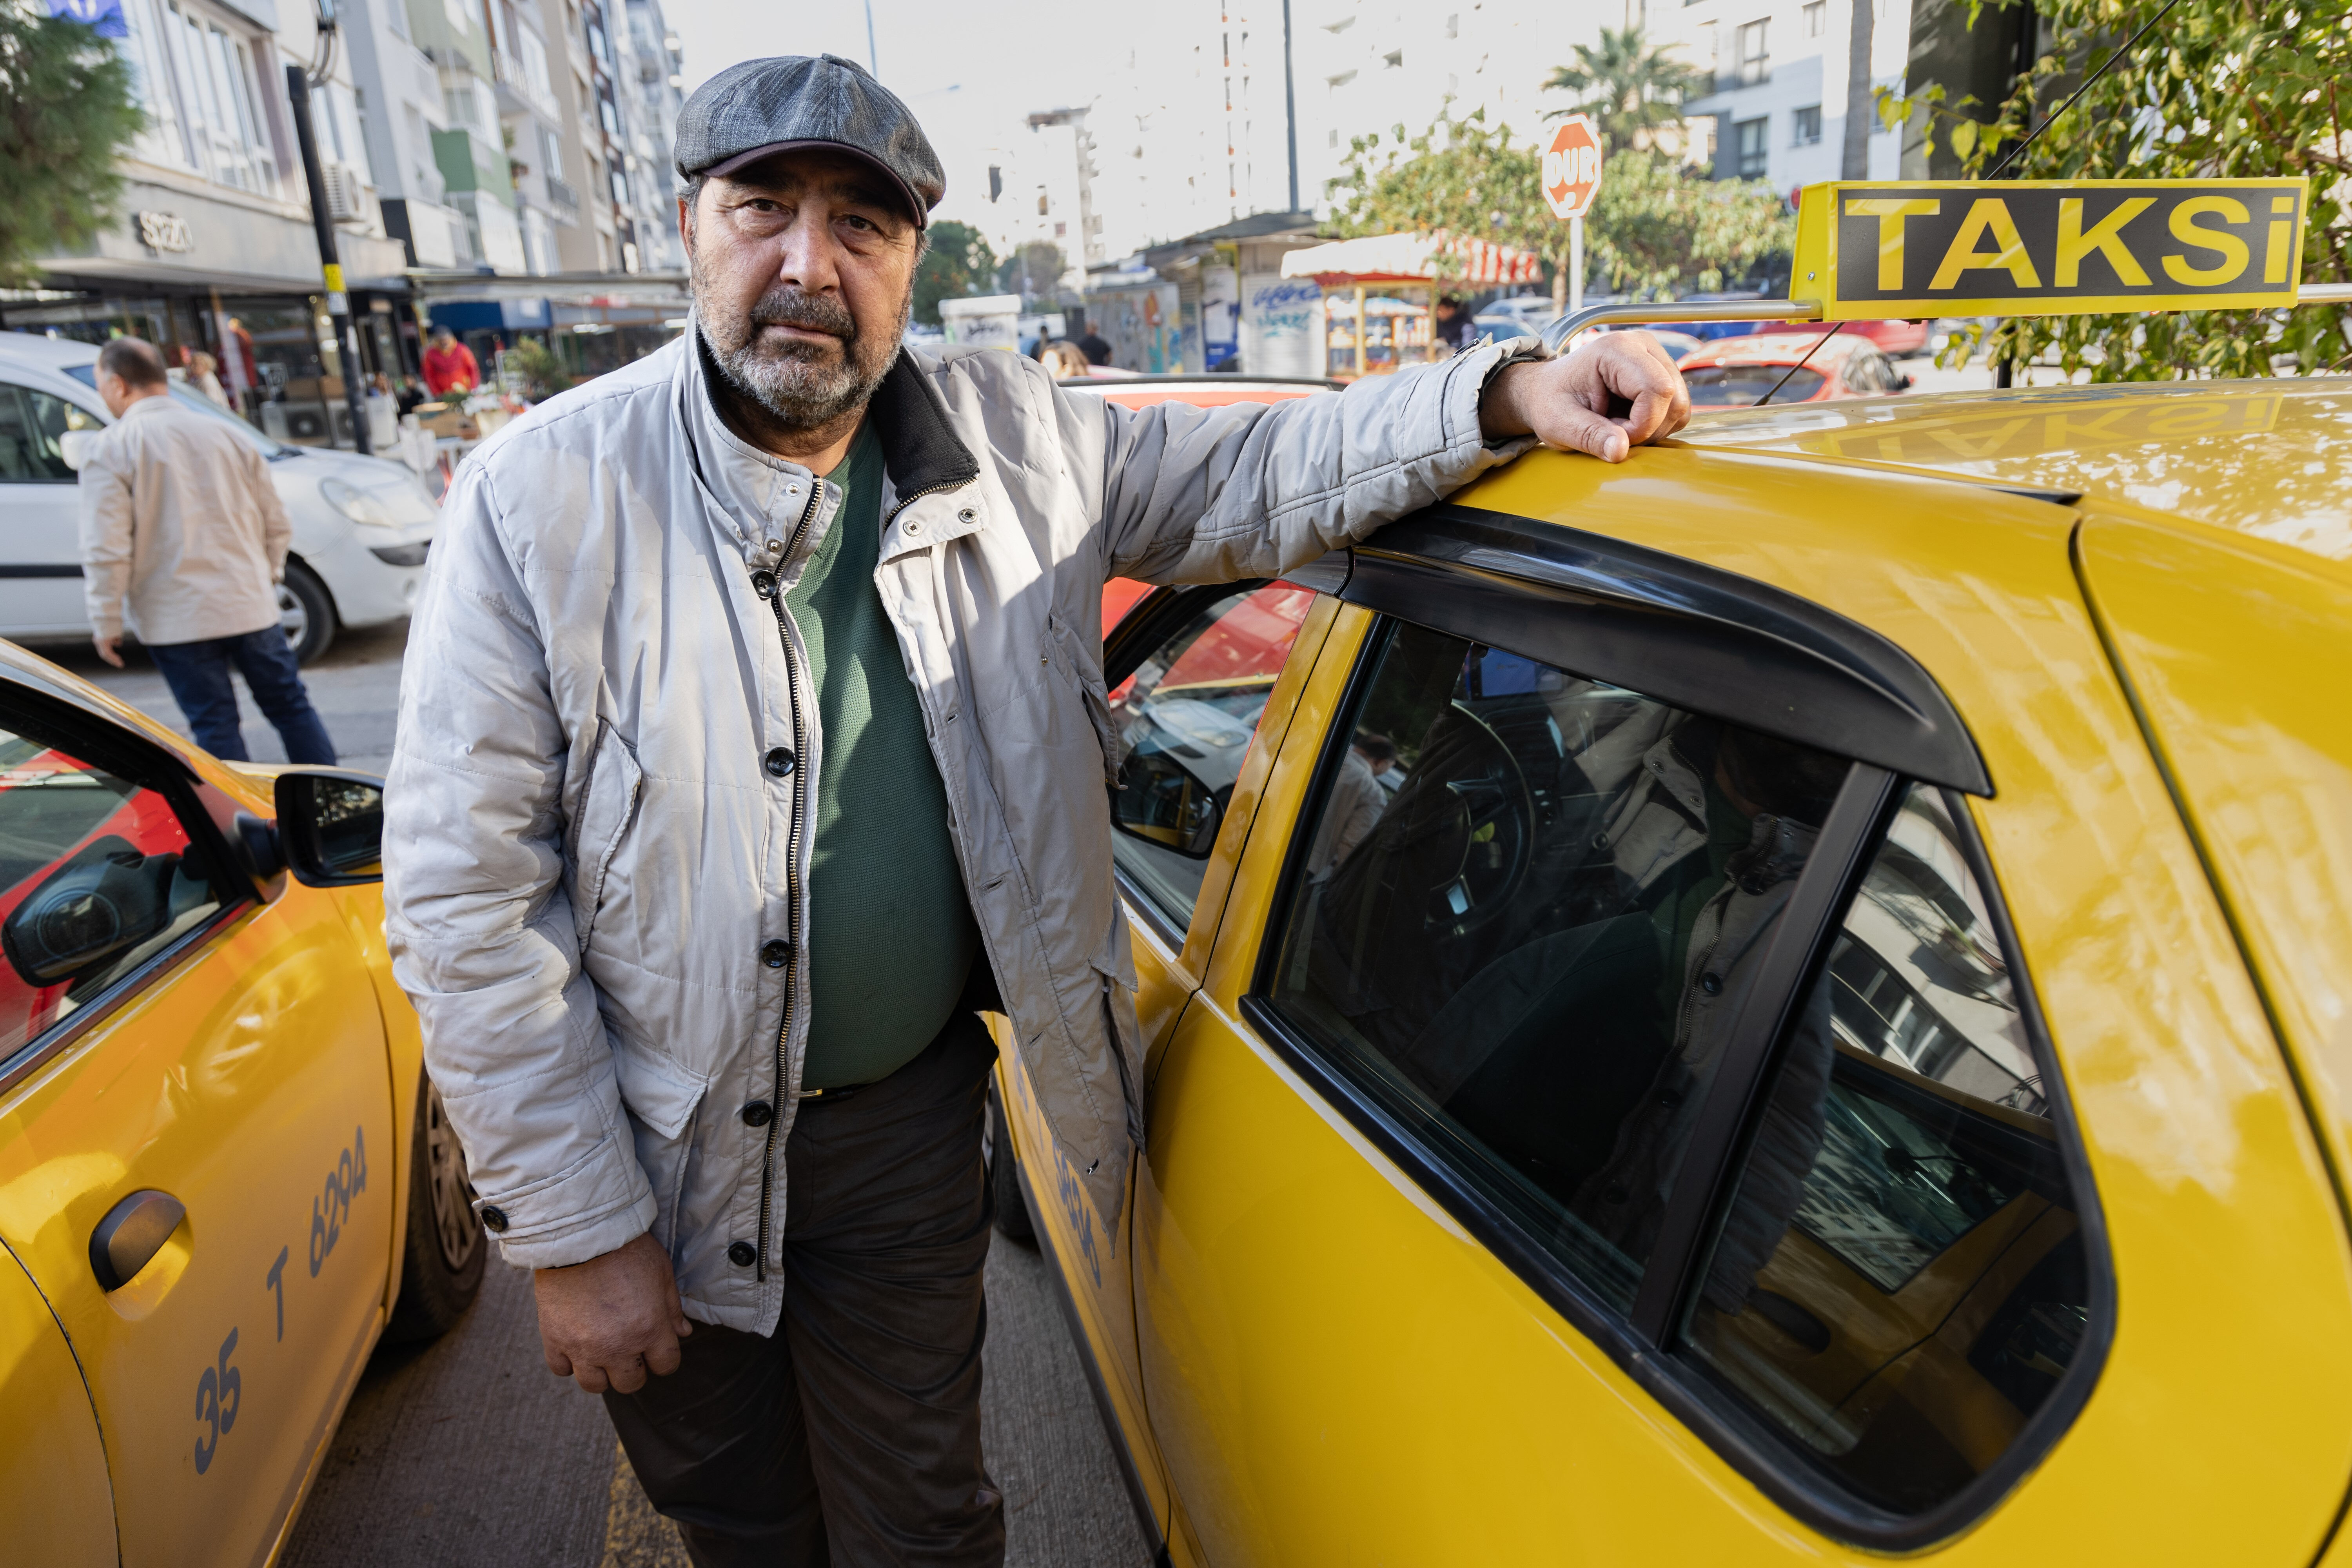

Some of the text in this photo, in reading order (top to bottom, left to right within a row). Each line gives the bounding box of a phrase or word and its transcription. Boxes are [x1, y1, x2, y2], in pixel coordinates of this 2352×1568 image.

[1548, 146, 1595, 187] DUR
[1844, 196, 2294, 290] TAKSi
[194, 1125, 367, 1475] 35 T 6294
